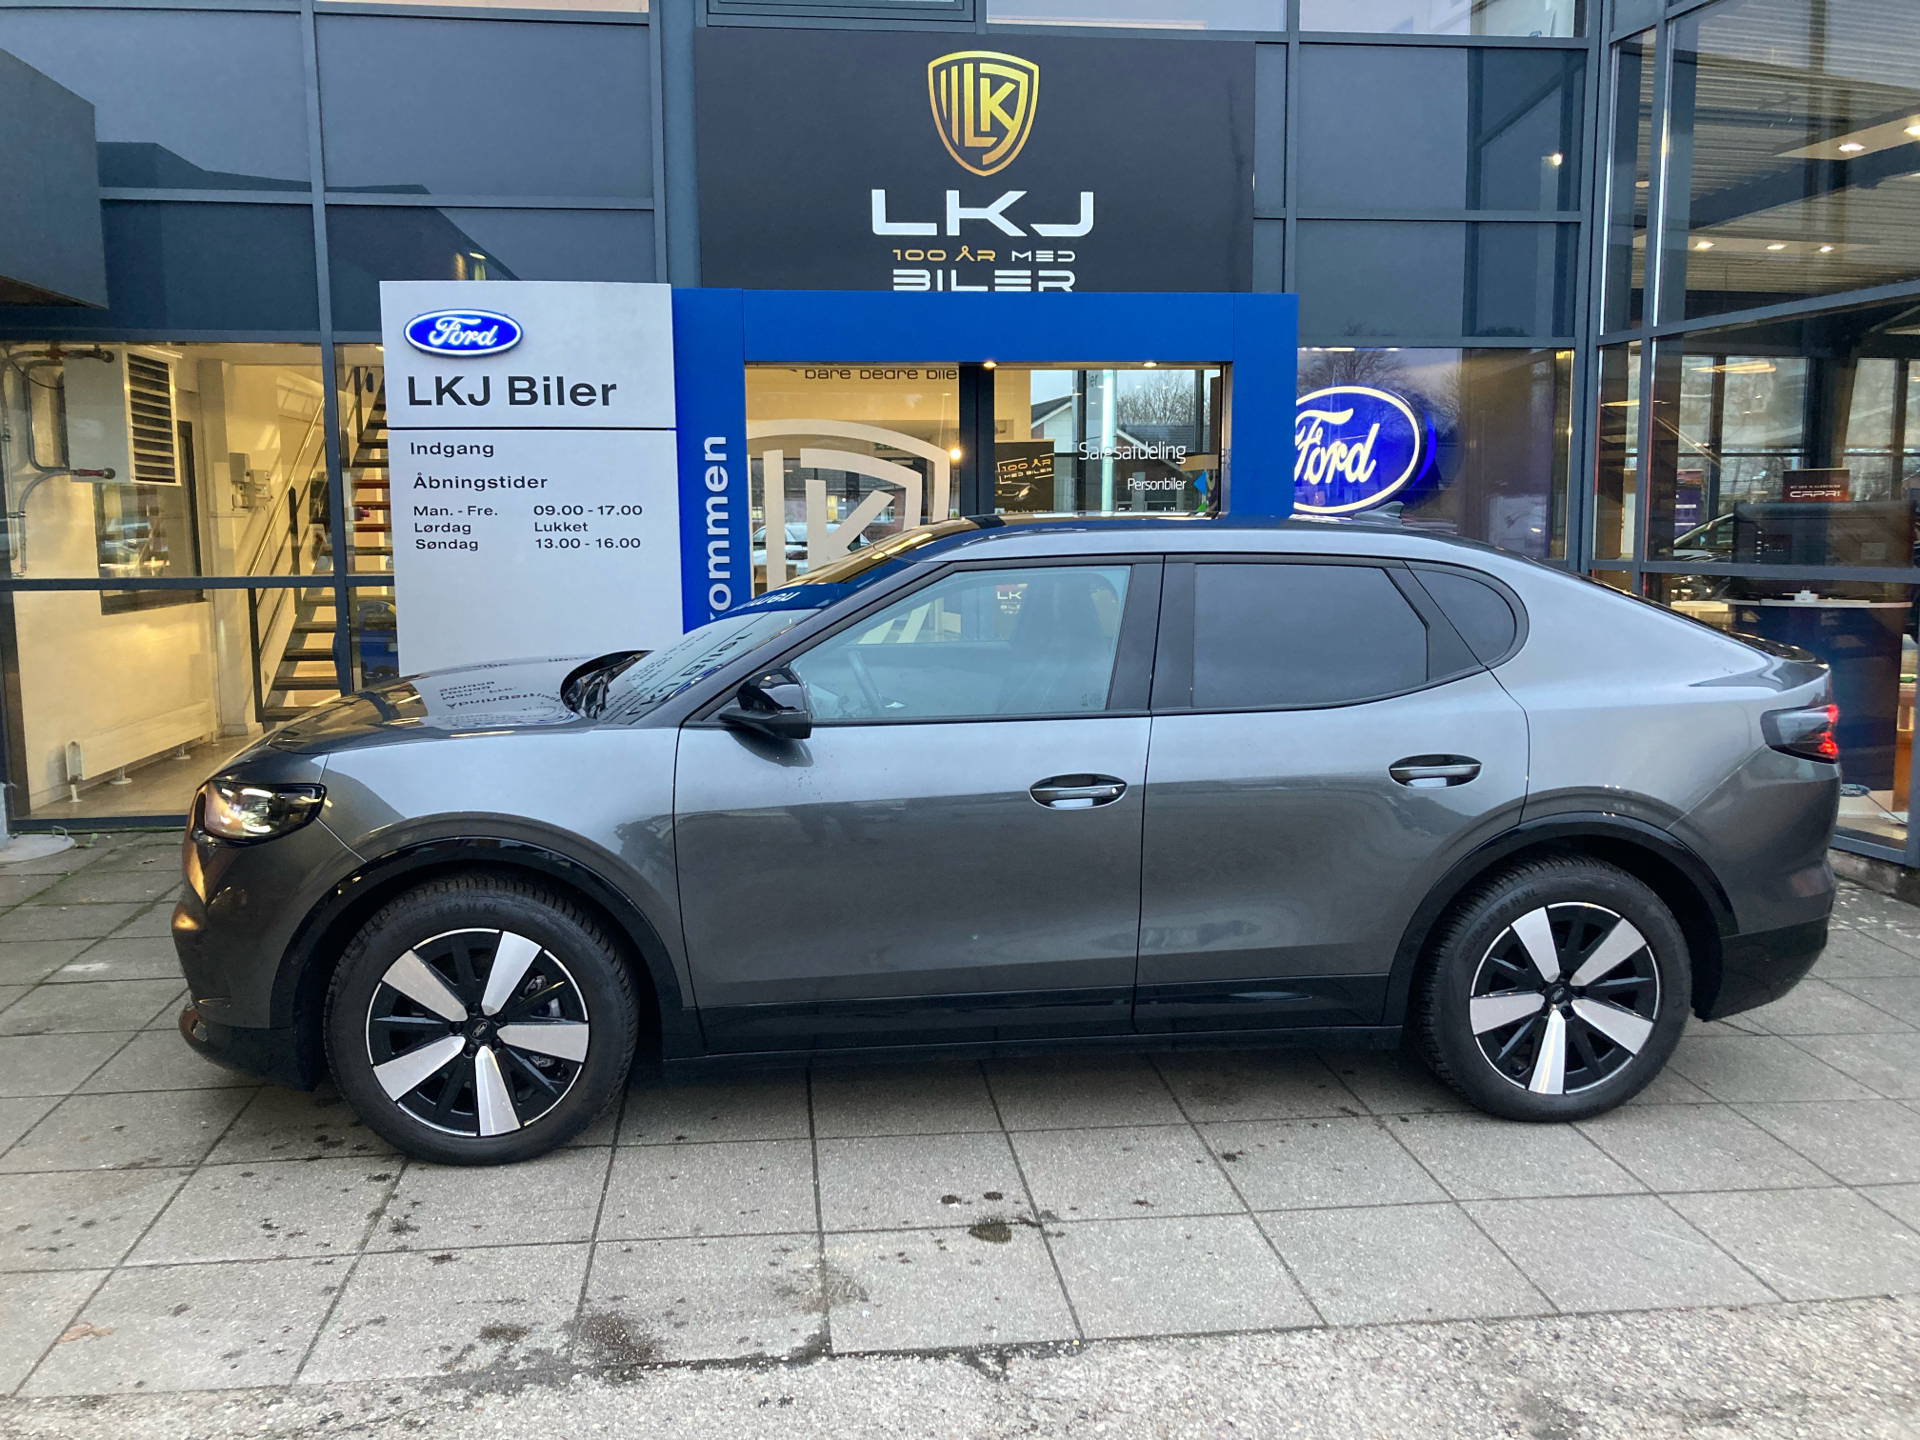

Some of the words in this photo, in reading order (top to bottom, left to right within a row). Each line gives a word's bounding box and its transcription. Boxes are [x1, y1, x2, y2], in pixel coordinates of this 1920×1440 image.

[871, 189, 1094, 237] LKJ
[893, 249, 947, 262] 100
[954, 245, 996, 262] ÅR
[1011, 250, 1076, 263] MED
[893, 269, 1076, 292] BILER
[428, 316, 499, 346] Ford
[407, 375, 491, 407] LKJ
[507, 375, 617, 407] Biler
[410, 442, 494, 458] Indgang
[1294, 407, 1381, 486] Ford
[413, 472, 548, 492] Åbningstider
[1127, 477, 1187, 491] Personbiler
[1789, 490, 1840, 498] CAPRI
[413, 506, 453, 516] Man.
[467, 505, 498, 516] Fre.
[533, 505, 584, 516] 09.00
[597, 505, 643, 516] 17.00
[414, 523, 471, 535] Lørdag
[534, 522, 588, 532] Lukket
[415, 539, 479, 552] Søndag
[535, 538, 581, 549] 13.00
[595, 538, 641, 549] 16.00
